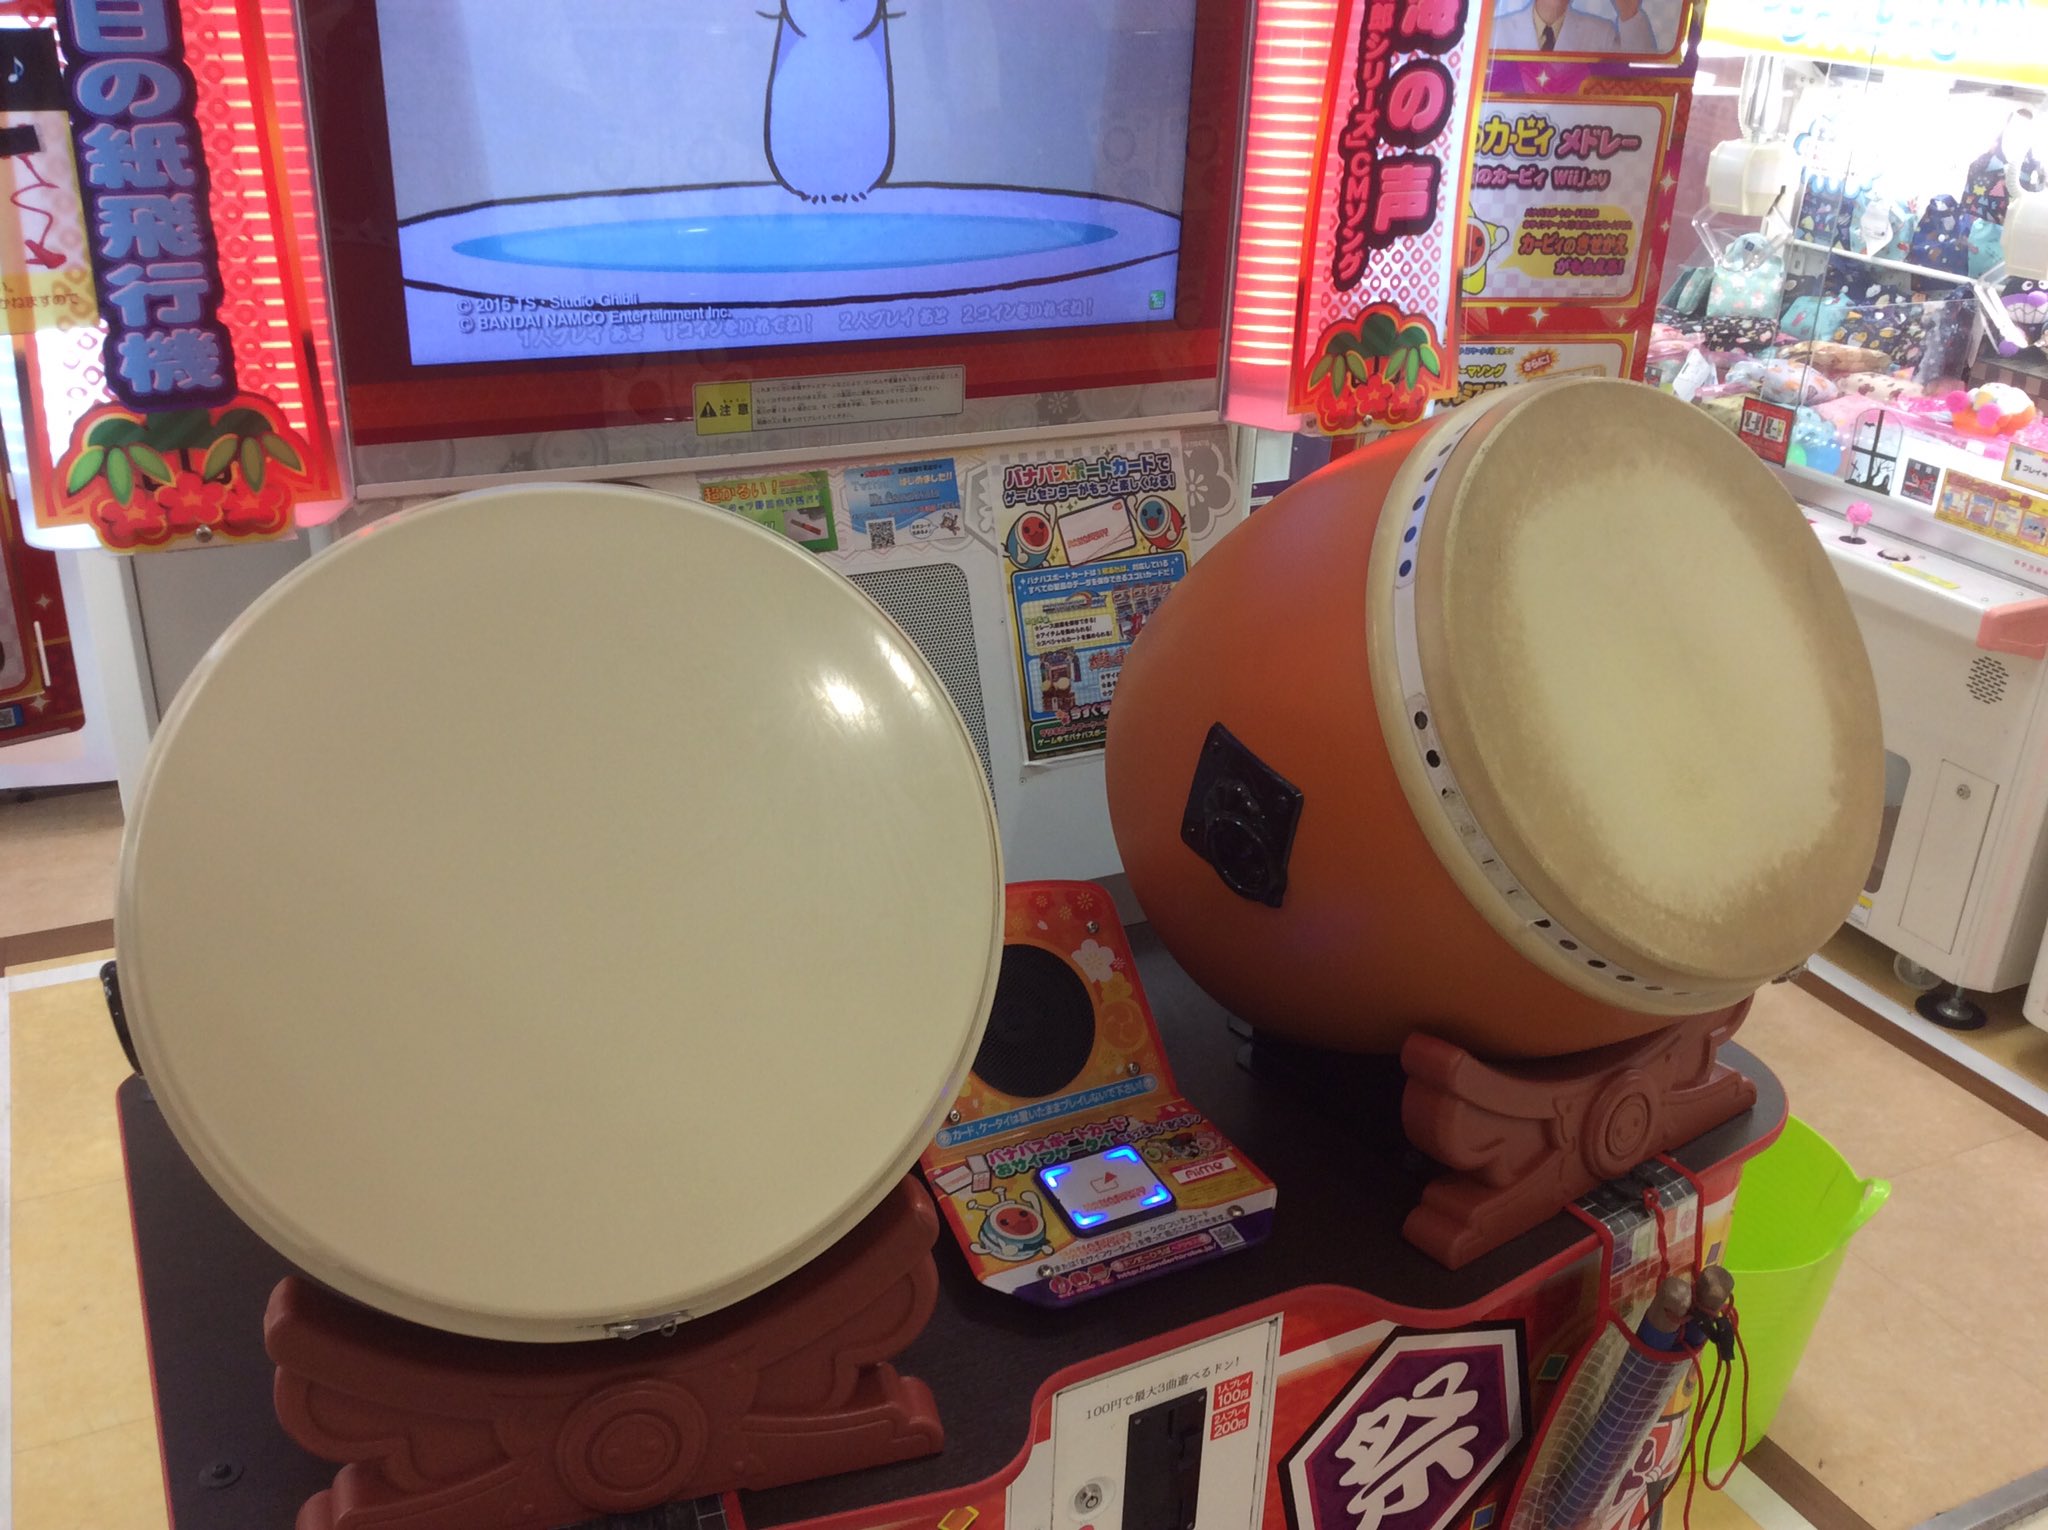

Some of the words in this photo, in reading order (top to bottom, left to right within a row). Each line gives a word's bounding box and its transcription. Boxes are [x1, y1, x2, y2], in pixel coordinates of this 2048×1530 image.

[1557, 125, 1642, 159] メドレー
[550, 294, 595, 309] Studio
[600, 292, 639, 307] Ghibli
[478, 314, 543, 331] BANDAI
[545, 310, 606, 327] NAMCO
[611, 306, 704, 325] Entertainment
[707, 305, 733, 320] Inc.
[719, 403, 750, 417] 注意
[1006, 453, 1171, 488] バナパスポートカードで
[1004, 473, 1176, 505] ゲームセンターがもっと楽しくなる!
[988, 1117, 1129, 1165] バナパスポートカード
[1086, 1356, 1240, 1420] 100円で最大3曲遊べるドン!
[1217, 1376, 1252, 1394] 1人プレイ
[1218, 1388, 1250, 1408] 100円
[1214, 1405, 1249, 1425] 2人プレイ
[1213, 1418, 1248, 1438] 200円
